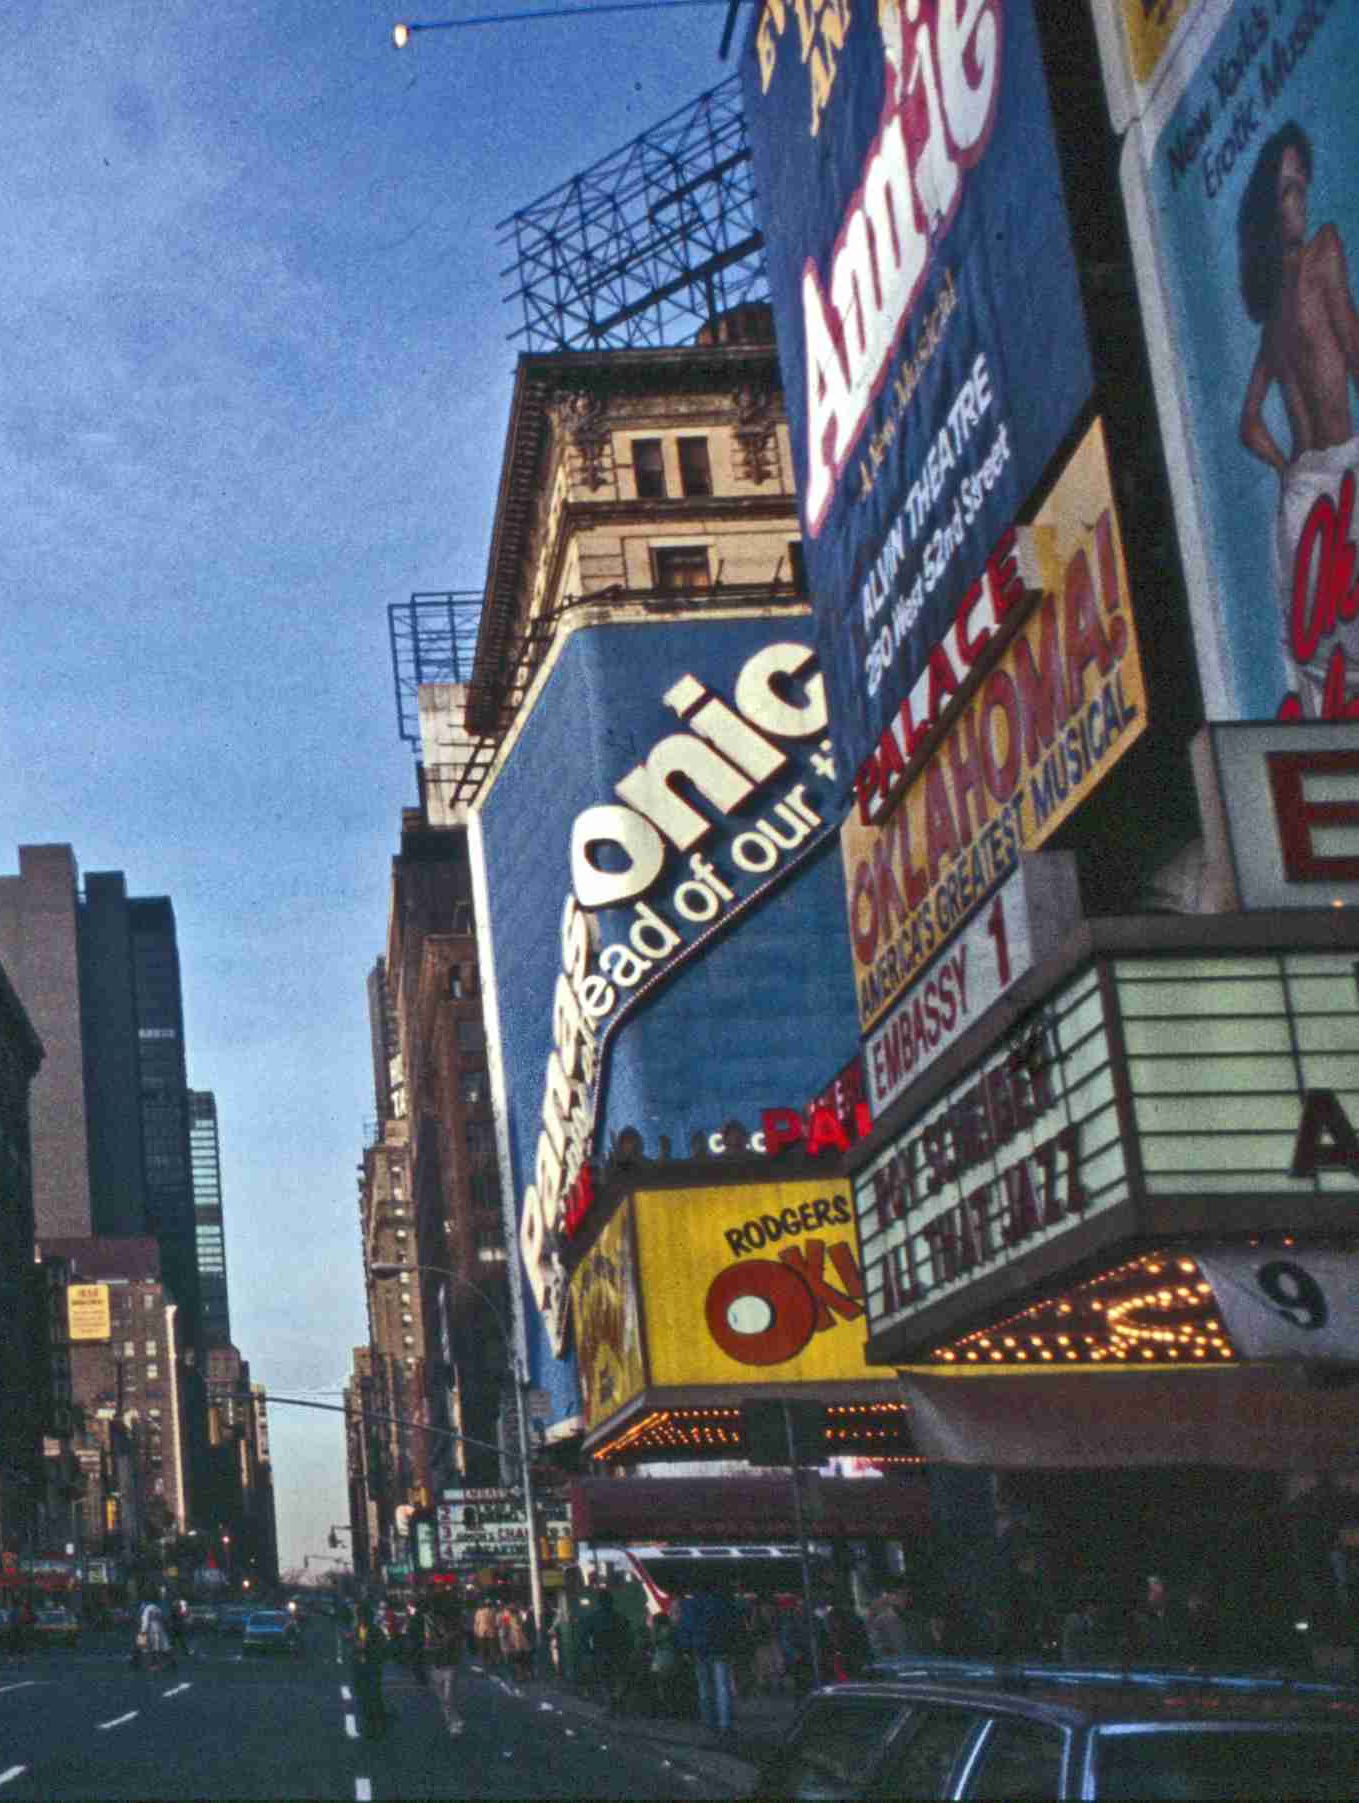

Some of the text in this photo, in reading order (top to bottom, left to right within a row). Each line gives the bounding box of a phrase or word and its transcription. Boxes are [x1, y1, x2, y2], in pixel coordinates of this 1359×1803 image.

[904, 351, 994, 540] THEATRE
[852, 526, 1028, 828] PALACE
[673, 851, 735, 922] of
[731, 781, 824, 873] our
[935, 789, 1025, 934] GREATEST
[1028, 668, 1138, 830] MUSICAL
[871, 894, 1013, 1102] EMBASSY 1
[723, 1194, 851, 1259] RODGERS
